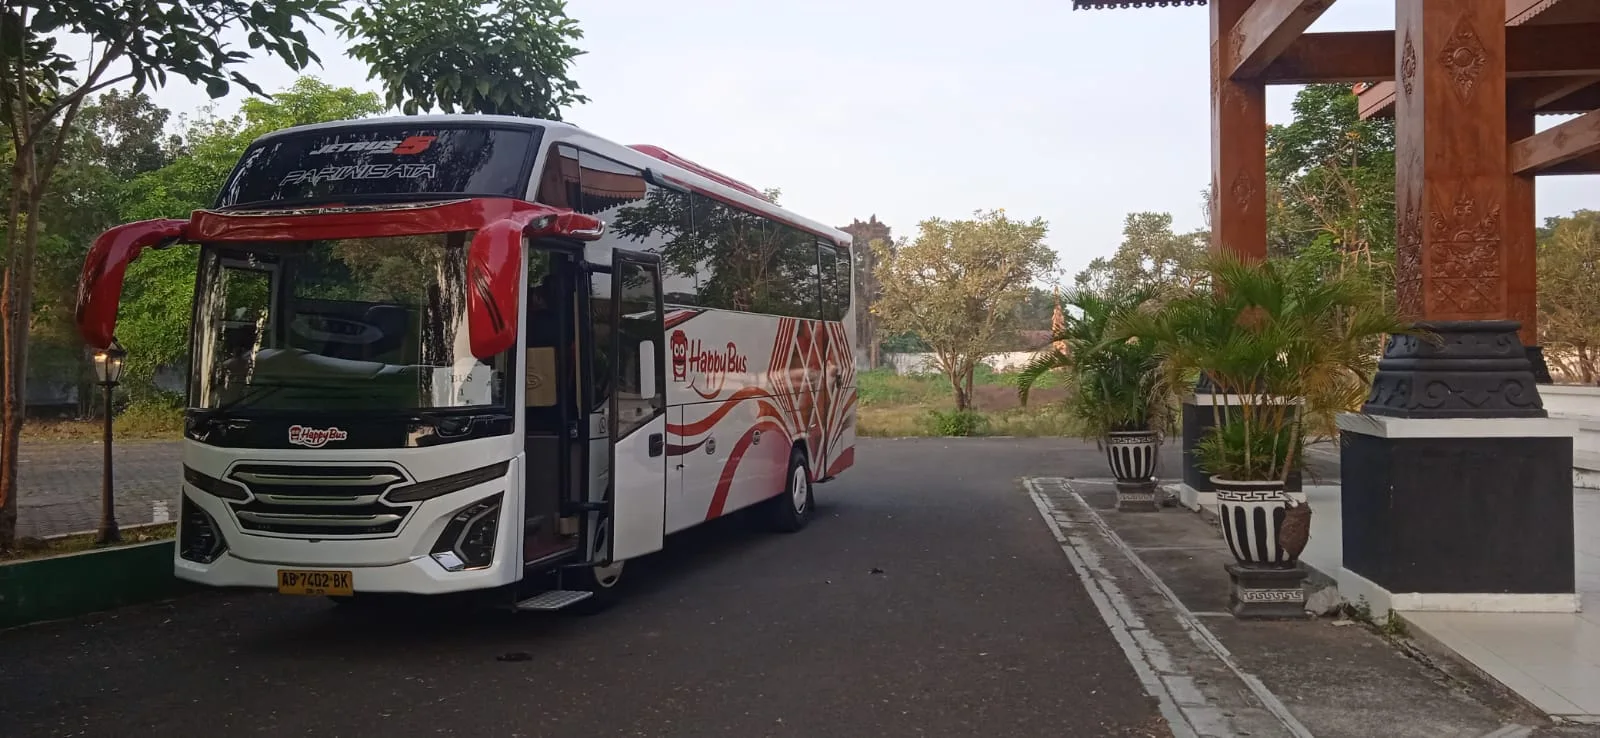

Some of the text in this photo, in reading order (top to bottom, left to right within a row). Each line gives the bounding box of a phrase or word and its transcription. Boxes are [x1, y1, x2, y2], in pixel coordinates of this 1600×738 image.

[278, 164, 437, 186] PARIWISATA
[450, 373, 473, 383] BUS
[282, 572, 348, 588] AB 7402 BK
